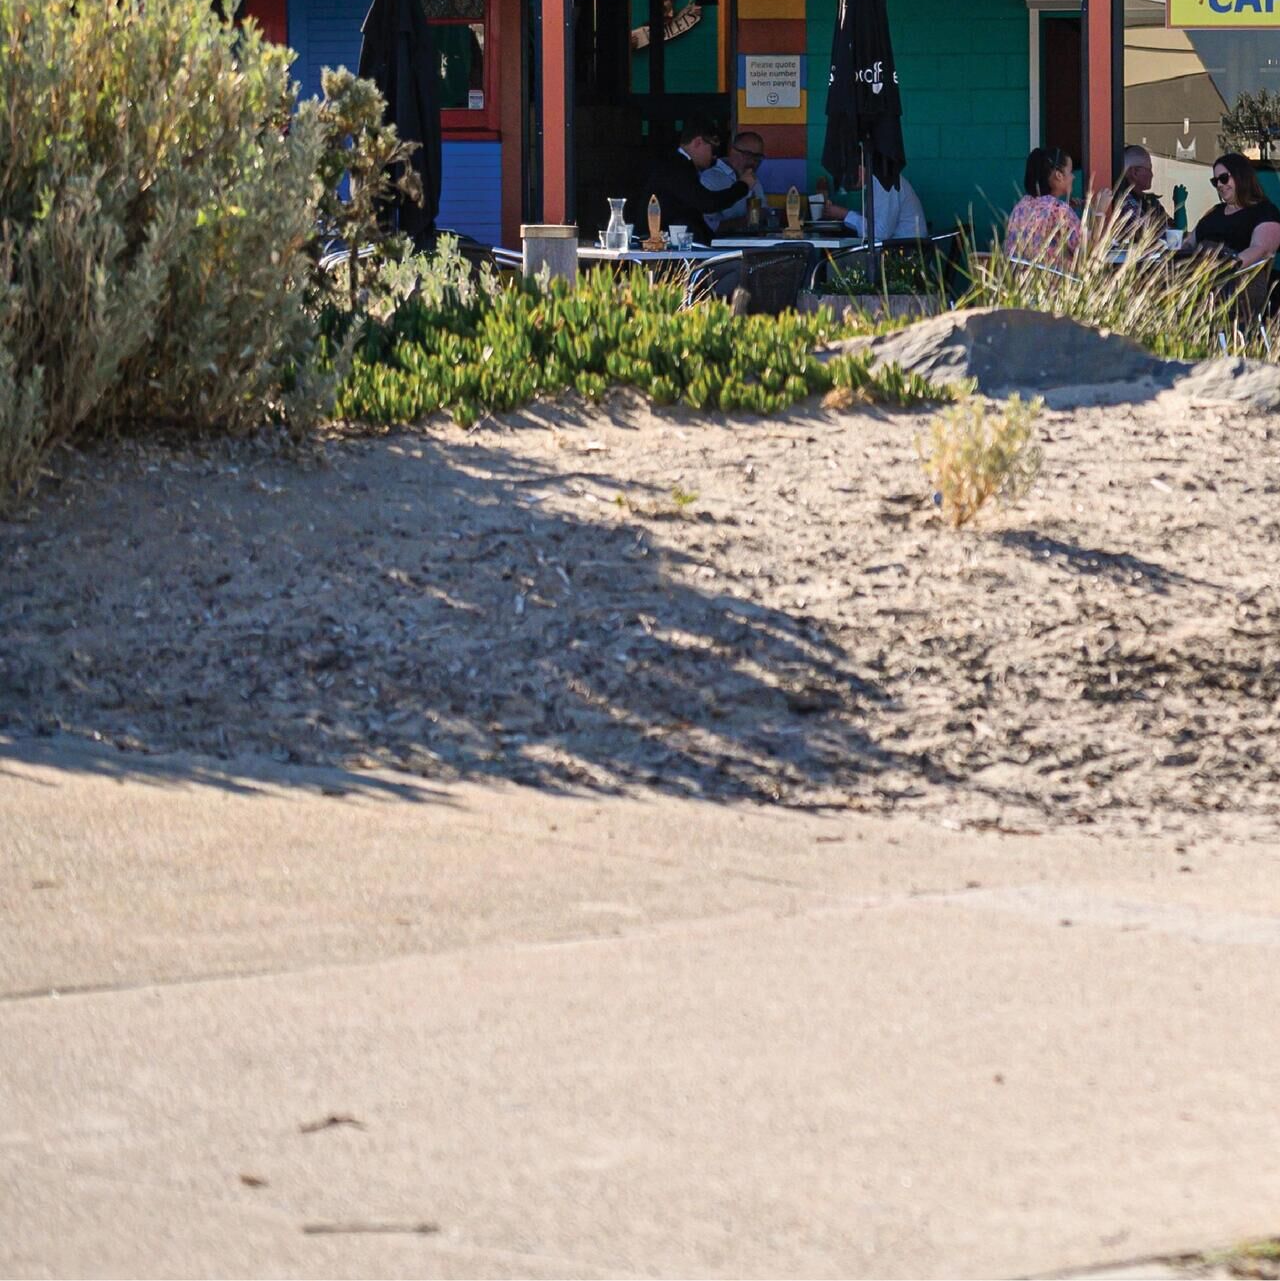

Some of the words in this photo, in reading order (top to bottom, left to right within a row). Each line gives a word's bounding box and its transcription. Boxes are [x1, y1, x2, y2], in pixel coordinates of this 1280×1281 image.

[751, 61, 774, 69] Please
[775, 61, 796, 70] quote
[750, 70, 768, 78] table
[769, 70, 797, 78] number
[772, 80, 796, 88] paying
